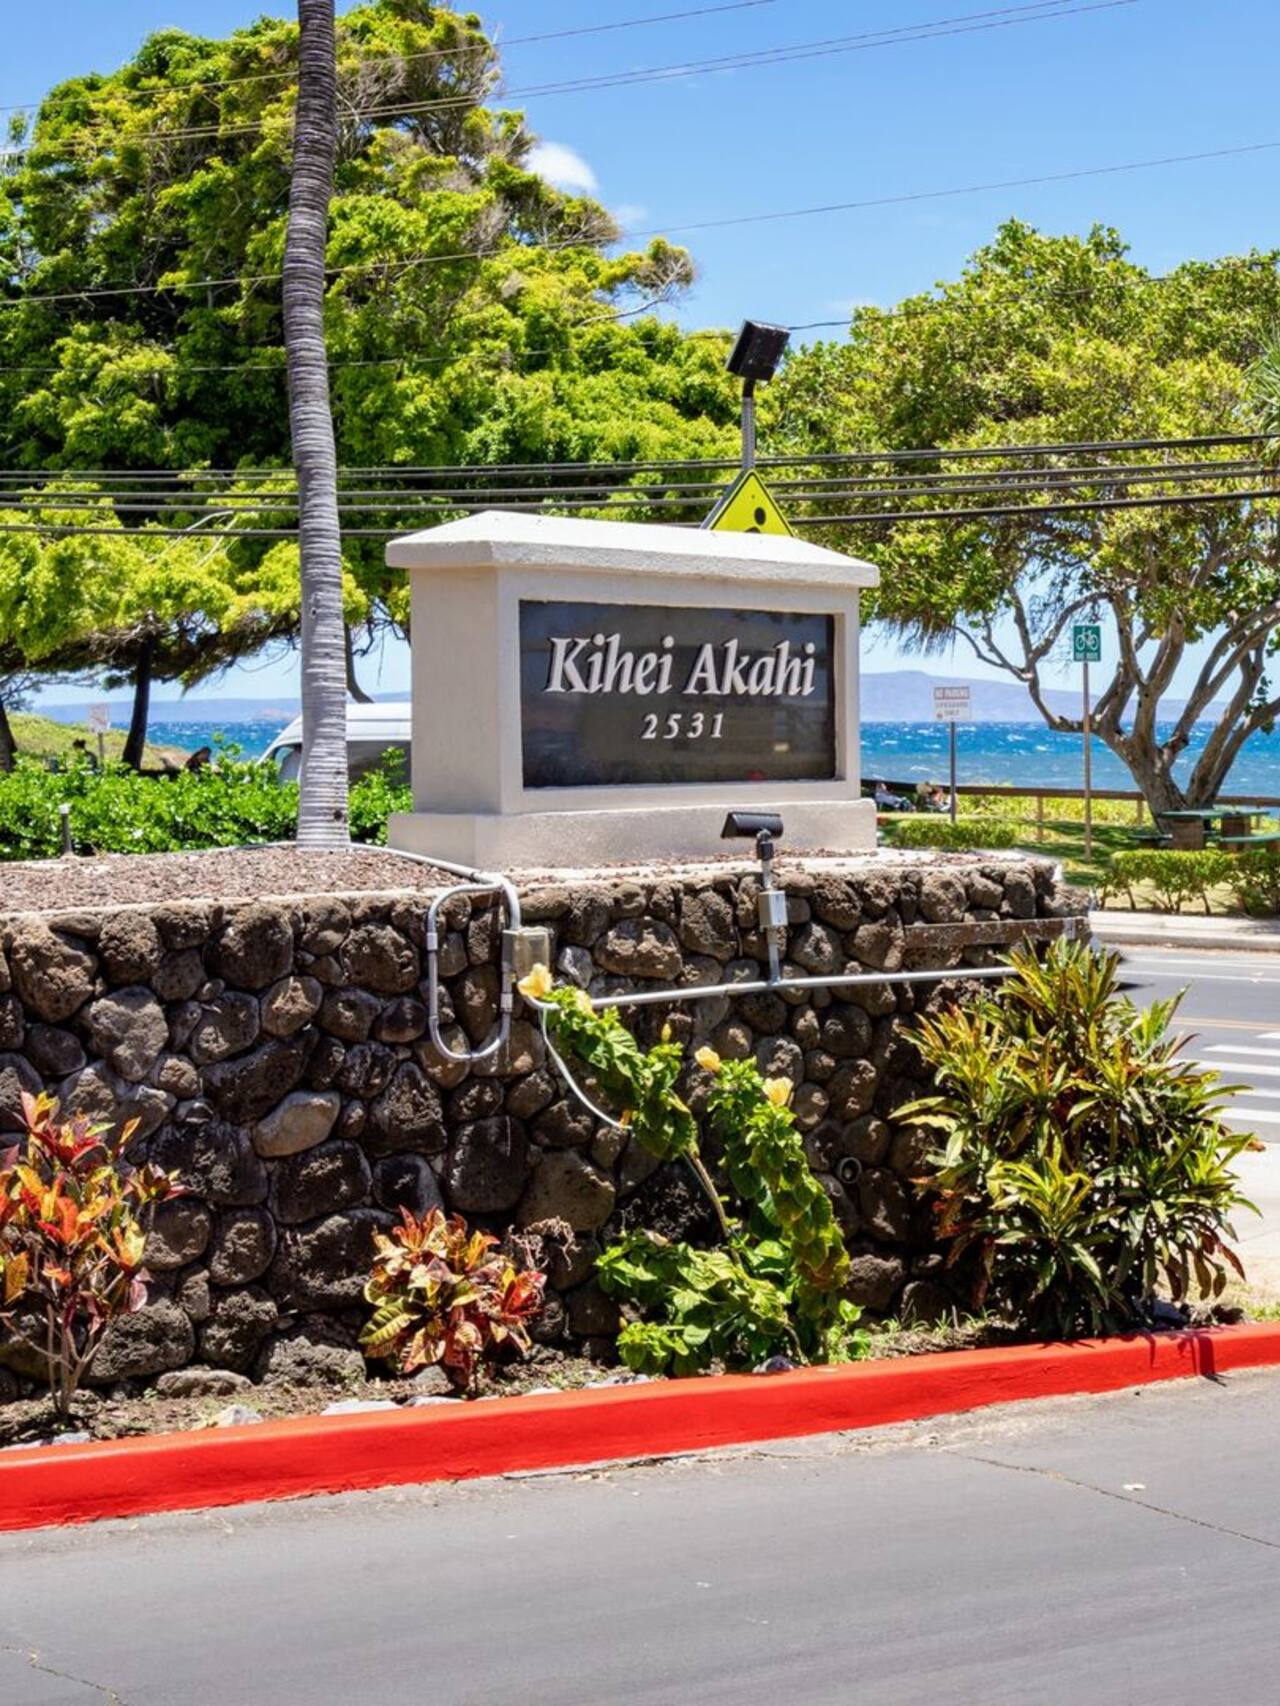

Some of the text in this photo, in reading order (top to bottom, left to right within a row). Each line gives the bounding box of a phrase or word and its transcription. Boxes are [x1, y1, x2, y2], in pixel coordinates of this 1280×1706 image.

[544, 633, 816, 696] Kihei Akahi
[641, 713, 724, 739] 2531
